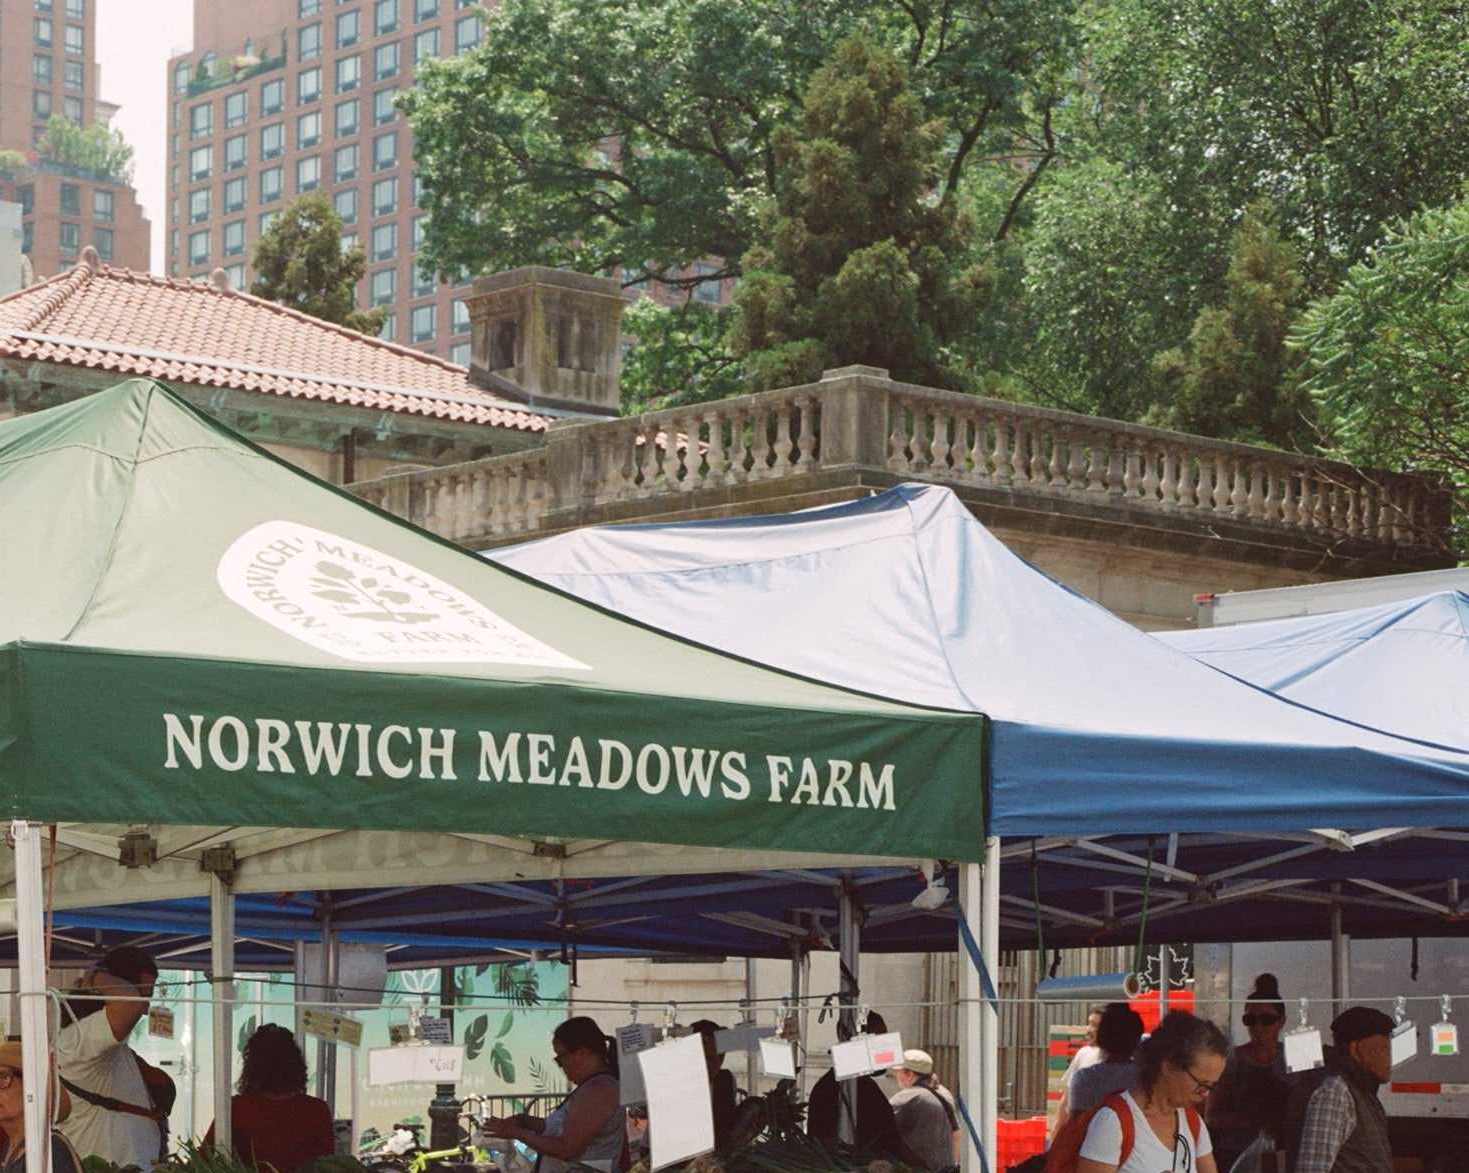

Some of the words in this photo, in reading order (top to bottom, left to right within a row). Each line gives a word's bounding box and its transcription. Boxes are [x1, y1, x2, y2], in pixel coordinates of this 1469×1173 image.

[245, 538, 327, 631] NORWICH
[314, 538, 500, 631] MEADOWS
[162, 712, 457, 781] NORWICH
[477, 730, 751, 801] MEADOWS
[766, 754, 897, 812] FARM
